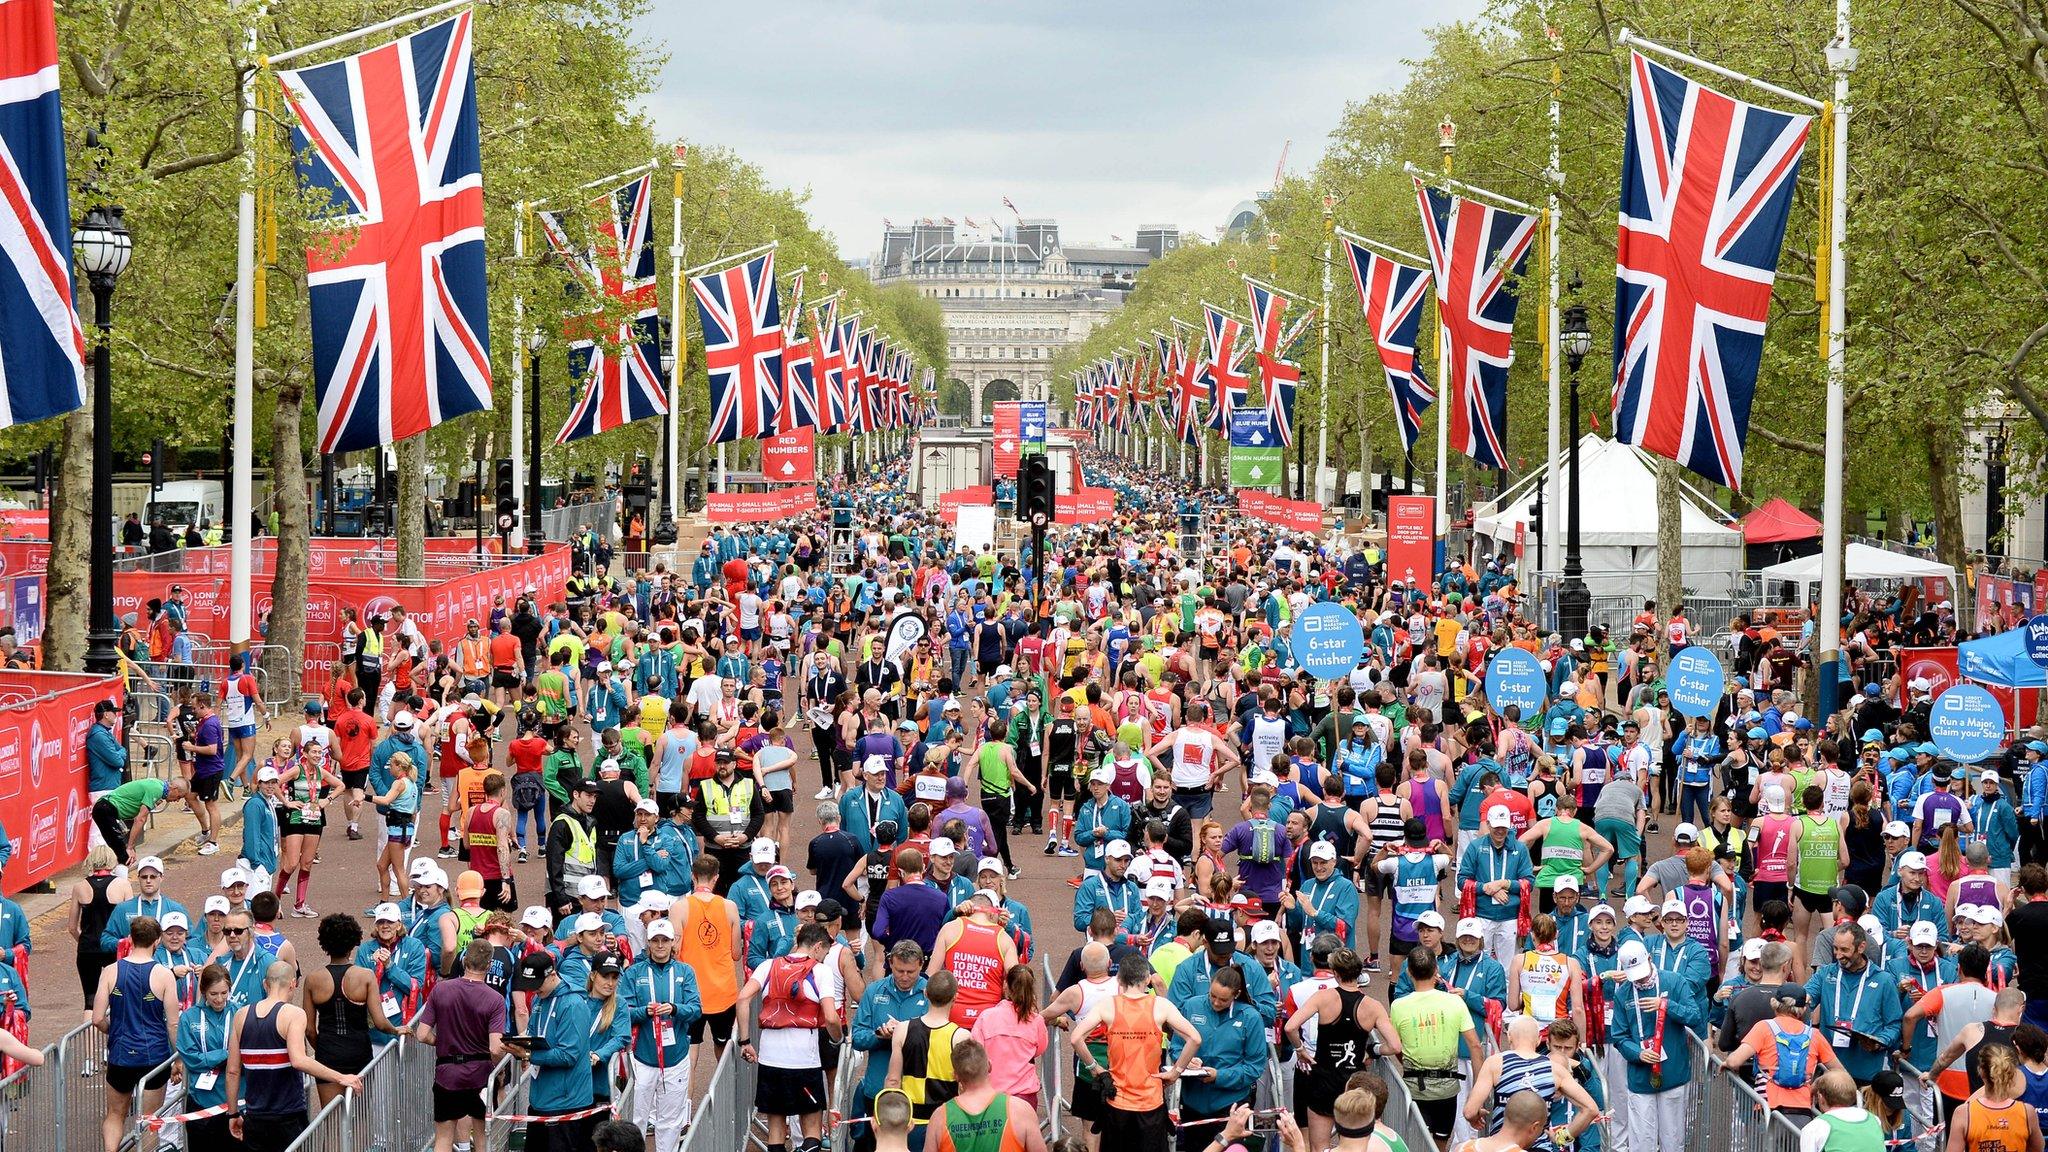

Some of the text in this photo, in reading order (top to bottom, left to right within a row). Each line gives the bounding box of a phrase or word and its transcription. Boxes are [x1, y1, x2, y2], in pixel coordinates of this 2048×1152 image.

[1309, 637, 1346, 650] 6-star
[305, 660, 331, 670] one
[1306, 652, 1352, 666] finisher
[1500, 680, 1531, 693] 6-star
[1680, 675, 1709, 691] 6-star
[1496, 694, 1535, 709] finisher
[1674, 689, 1711, 707] finisher
[1940, 716, 1957, 726] Run
[1967, 718, 1995, 730] Major,
[1932, 726, 2001, 739] Claim your Star
[1944, 746, 1989, 761] AbbottWMM.com
[954, 952, 998, 968] RUNNING
[954, 961, 990, 974] TO BEAT
[1528, 964, 1563, 974] ALYSSA
[953, 970, 984, 980] BLOOD
[957, 979, 988, 990] ANCER
